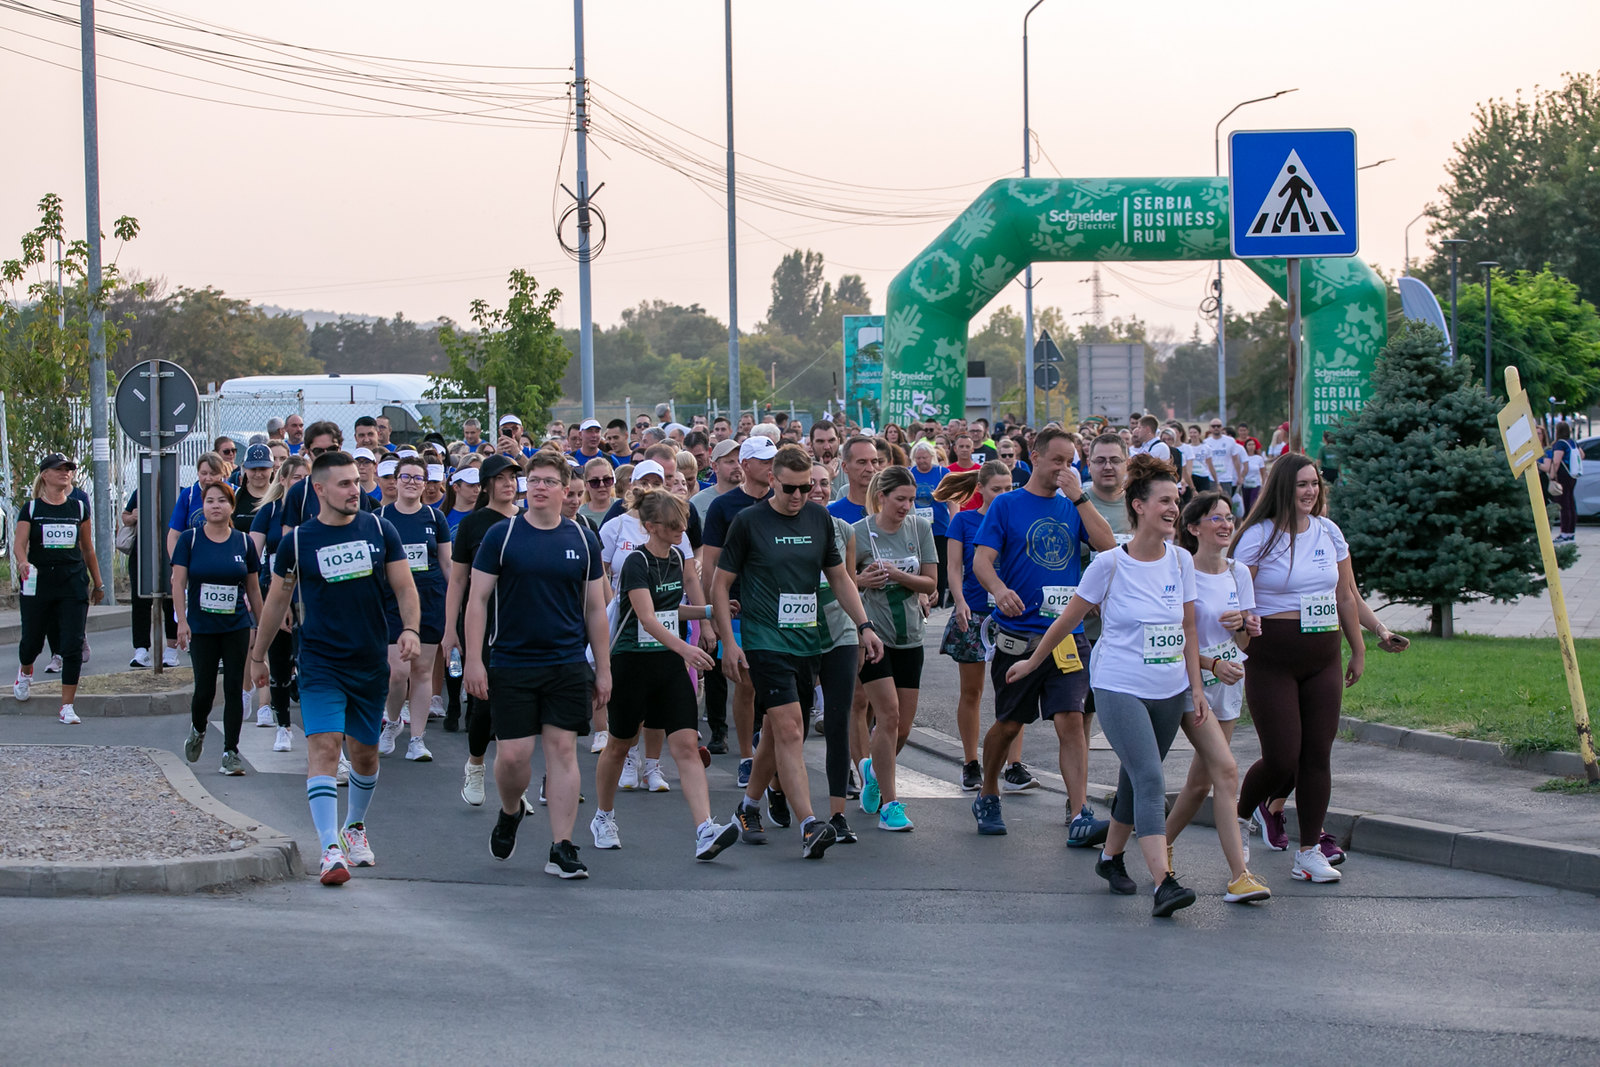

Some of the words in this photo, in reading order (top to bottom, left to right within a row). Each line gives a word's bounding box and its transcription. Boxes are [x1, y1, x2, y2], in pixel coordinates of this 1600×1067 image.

[1133, 196, 1192, 210] SERBIA
[1050, 209, 1118, 226] Schneider
[1133, 211, 1216, 227] BUSINESS
[1079, 222, 1117, 230] Electric
[1133, 229, 1167, 243] RUN
[891, 371, 935, 382] Schneider
[1314, 368, 1360, 379] Schneider
[1314, 387, 1360, 398] SERBIA
[1314, 400, 1364, 411] BUSINE
[46, 530, 74, 538] 0019
[425, 527, 435, 535] n.
[775, 536, 812, 544] HTEC
[234, 554, 244, 563] n.
[323, 550, 365, 567] 1034
[408, 551, 423, 560] 37
[565, 549, 580, 559] n.
[656, 581, 682, 593] HTEC
[204, 591, 235, 602] 1036
[1048, 595, 1074, 606] 012
[783, 603, 816, 614] 0700
[1306, 604, 1336, 617] 1308
[662, 620, 676, 631] 91
[1149, 635, 1184, 647] 1309
[1213, 646, 1238, 661] 93
